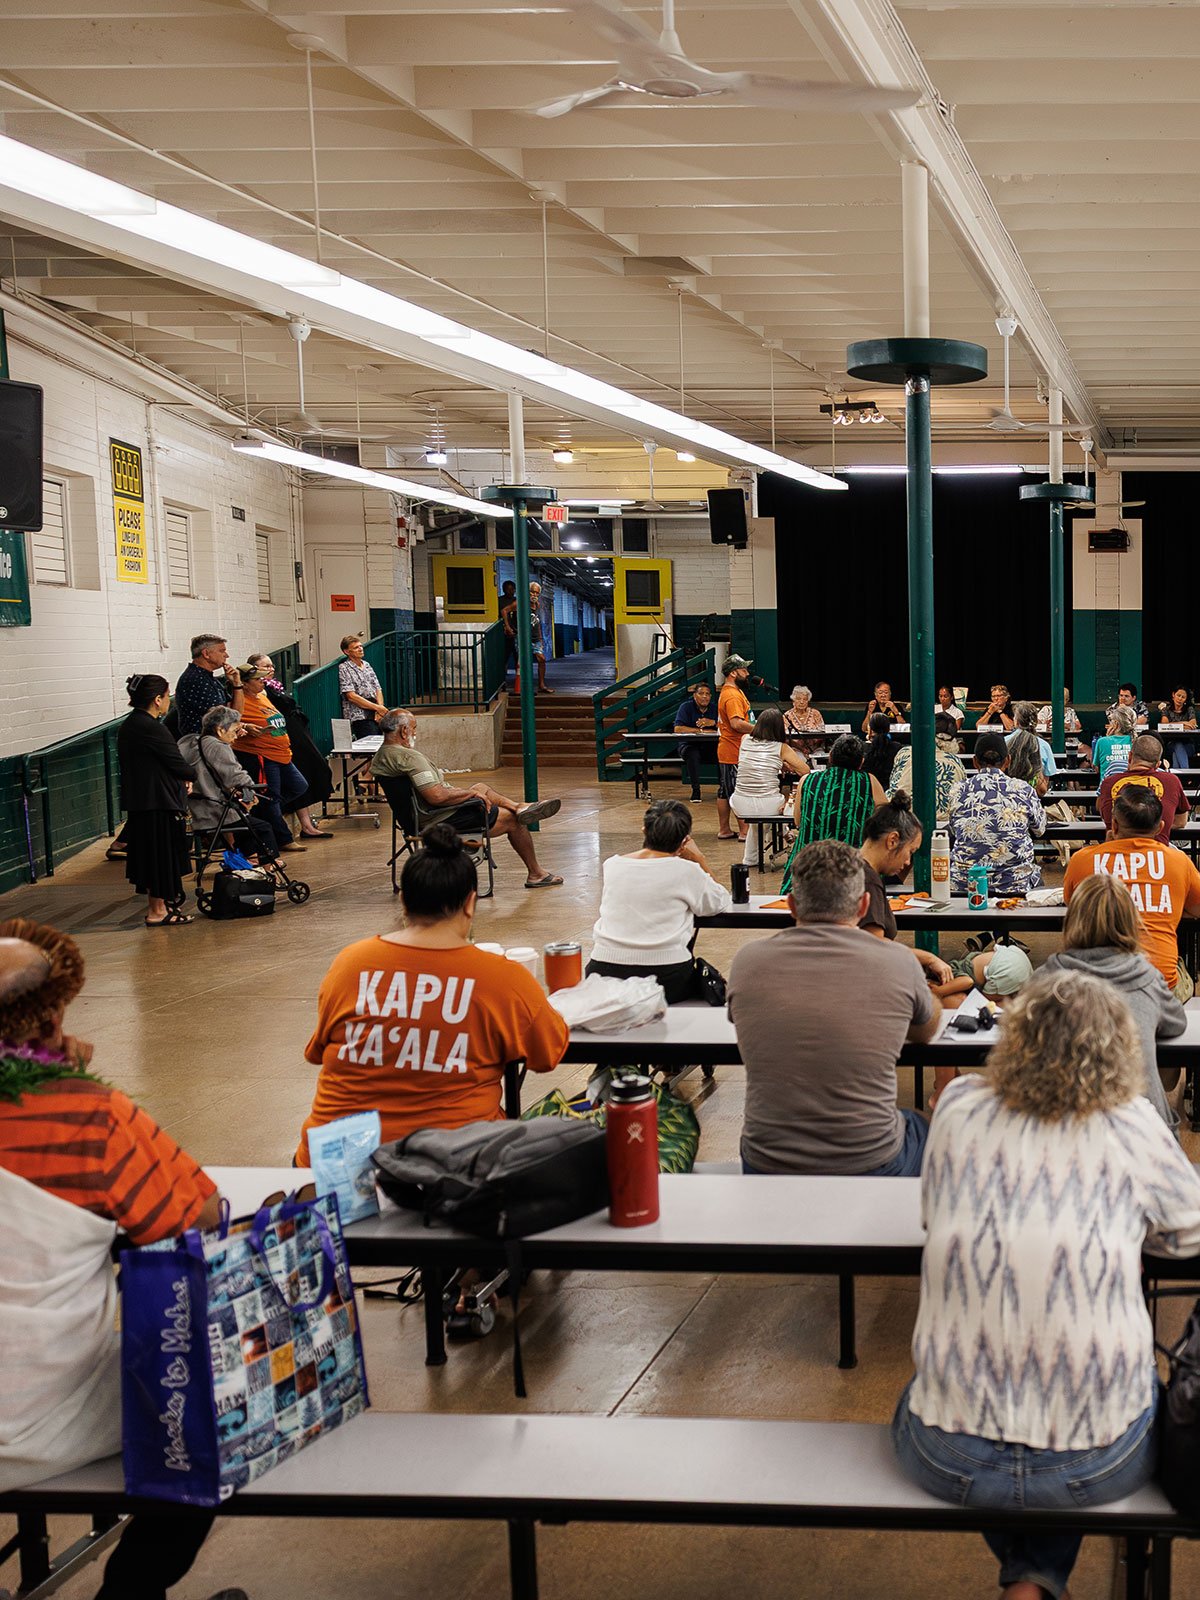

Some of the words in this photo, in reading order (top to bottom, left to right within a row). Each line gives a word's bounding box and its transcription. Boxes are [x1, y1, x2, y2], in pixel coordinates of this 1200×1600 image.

[118, 508, 141, 530] PLEASE
[547, 508, 564, 520] EXIT
[122, 531, 131, 543] LINE
[126, 546, 144, 558] ORDERLY
[125, 559, 141, 572] FASHION
[1094, 851, 1165, 880] KAPU
[355, 970, 476, 1024] KAPU
[160, 1356, 191, 1388] to
